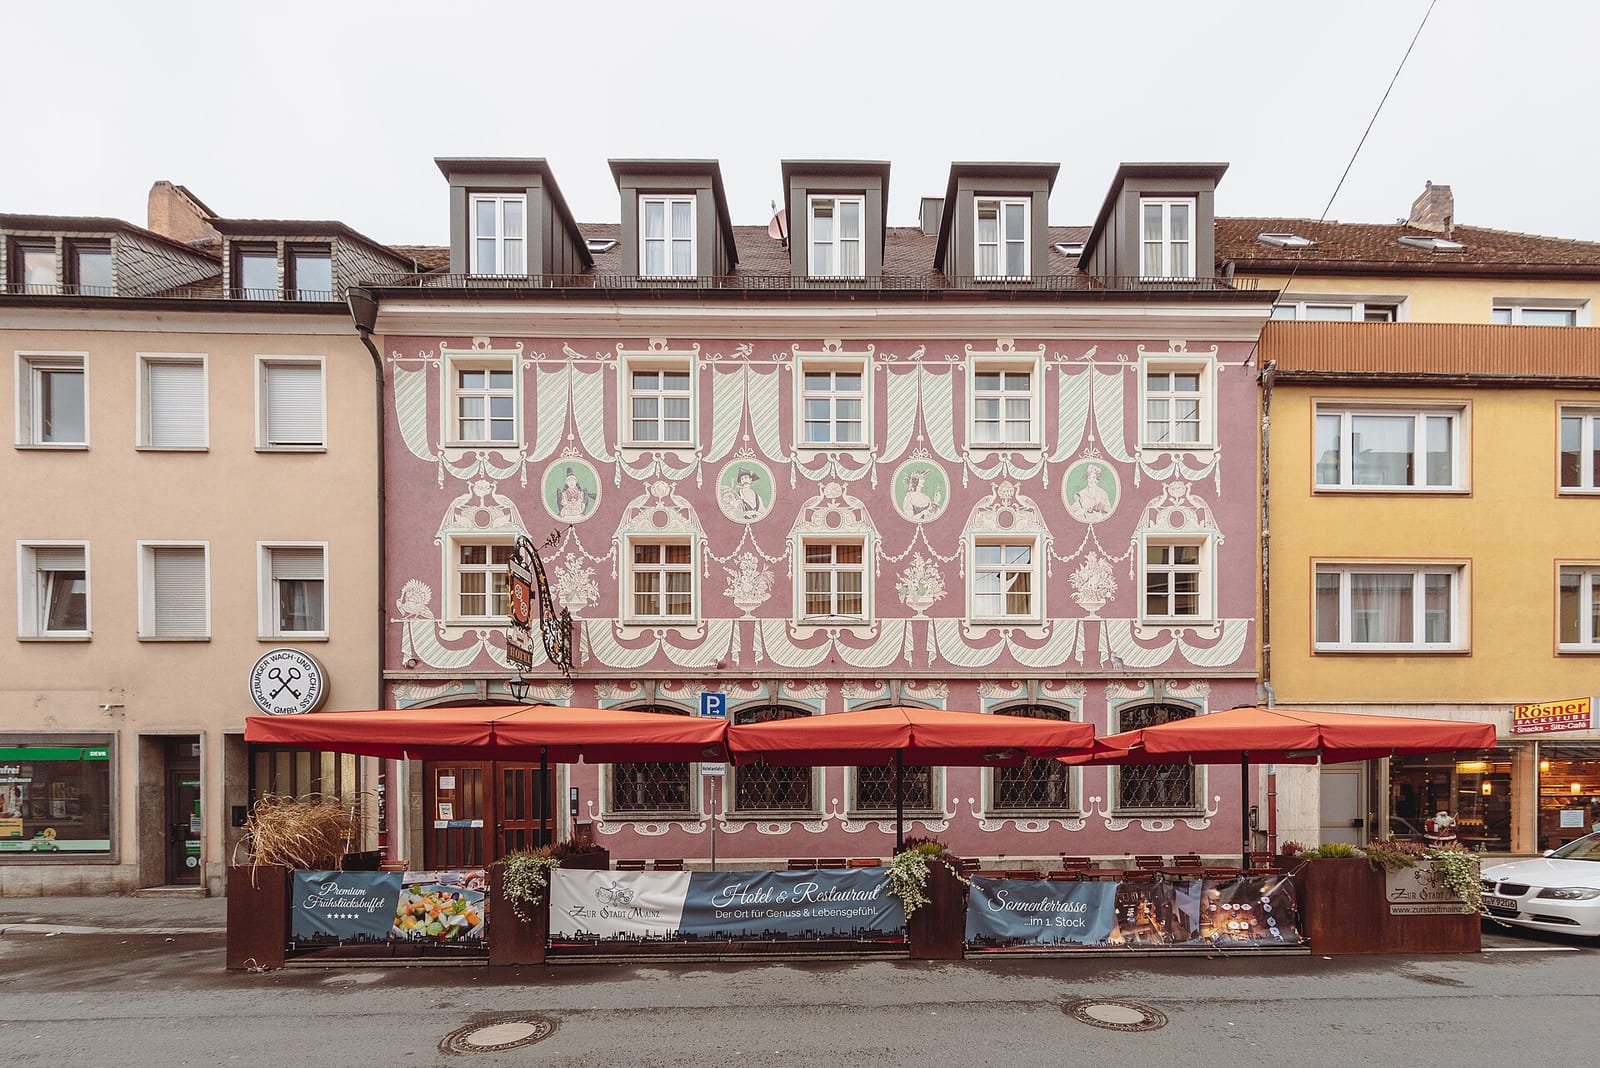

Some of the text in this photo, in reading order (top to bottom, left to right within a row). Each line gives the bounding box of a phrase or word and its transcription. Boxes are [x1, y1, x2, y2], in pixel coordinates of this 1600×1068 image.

[508, 645, 531, 664] HOTEL
[300, 672, 317, 709] SCHLIESS
[706, 695, 720, 714] P
[1517, 702, 1587, 719] Rösner
[1517, 714, 1587, 725] BACKSTUBE
[1517, 725, 1544, 733] Snacks
[1550, 722, 1587, 731] Sitz-Café
[318, 881, 367, 896] Premium
[711, 882, 882, 908] Hotel & Restaurant
[1391, 888, 1416, 900] ZUR
[1419, 887, 1444, 900] STADT
[302, 894, 385, 913] Frühstücksbuffet
[987, 889, 1088, 913] Sonnenterrasse
[568, 905, 597, 918] ZUR
[599, 905, 627, 919] STADT
[715, 906, 878, 919] Der Ort für Genuss & Lebensgefühl
[1045, 918, 1053, 927] 1.
[1055, 916, 1086, 927] Stock
